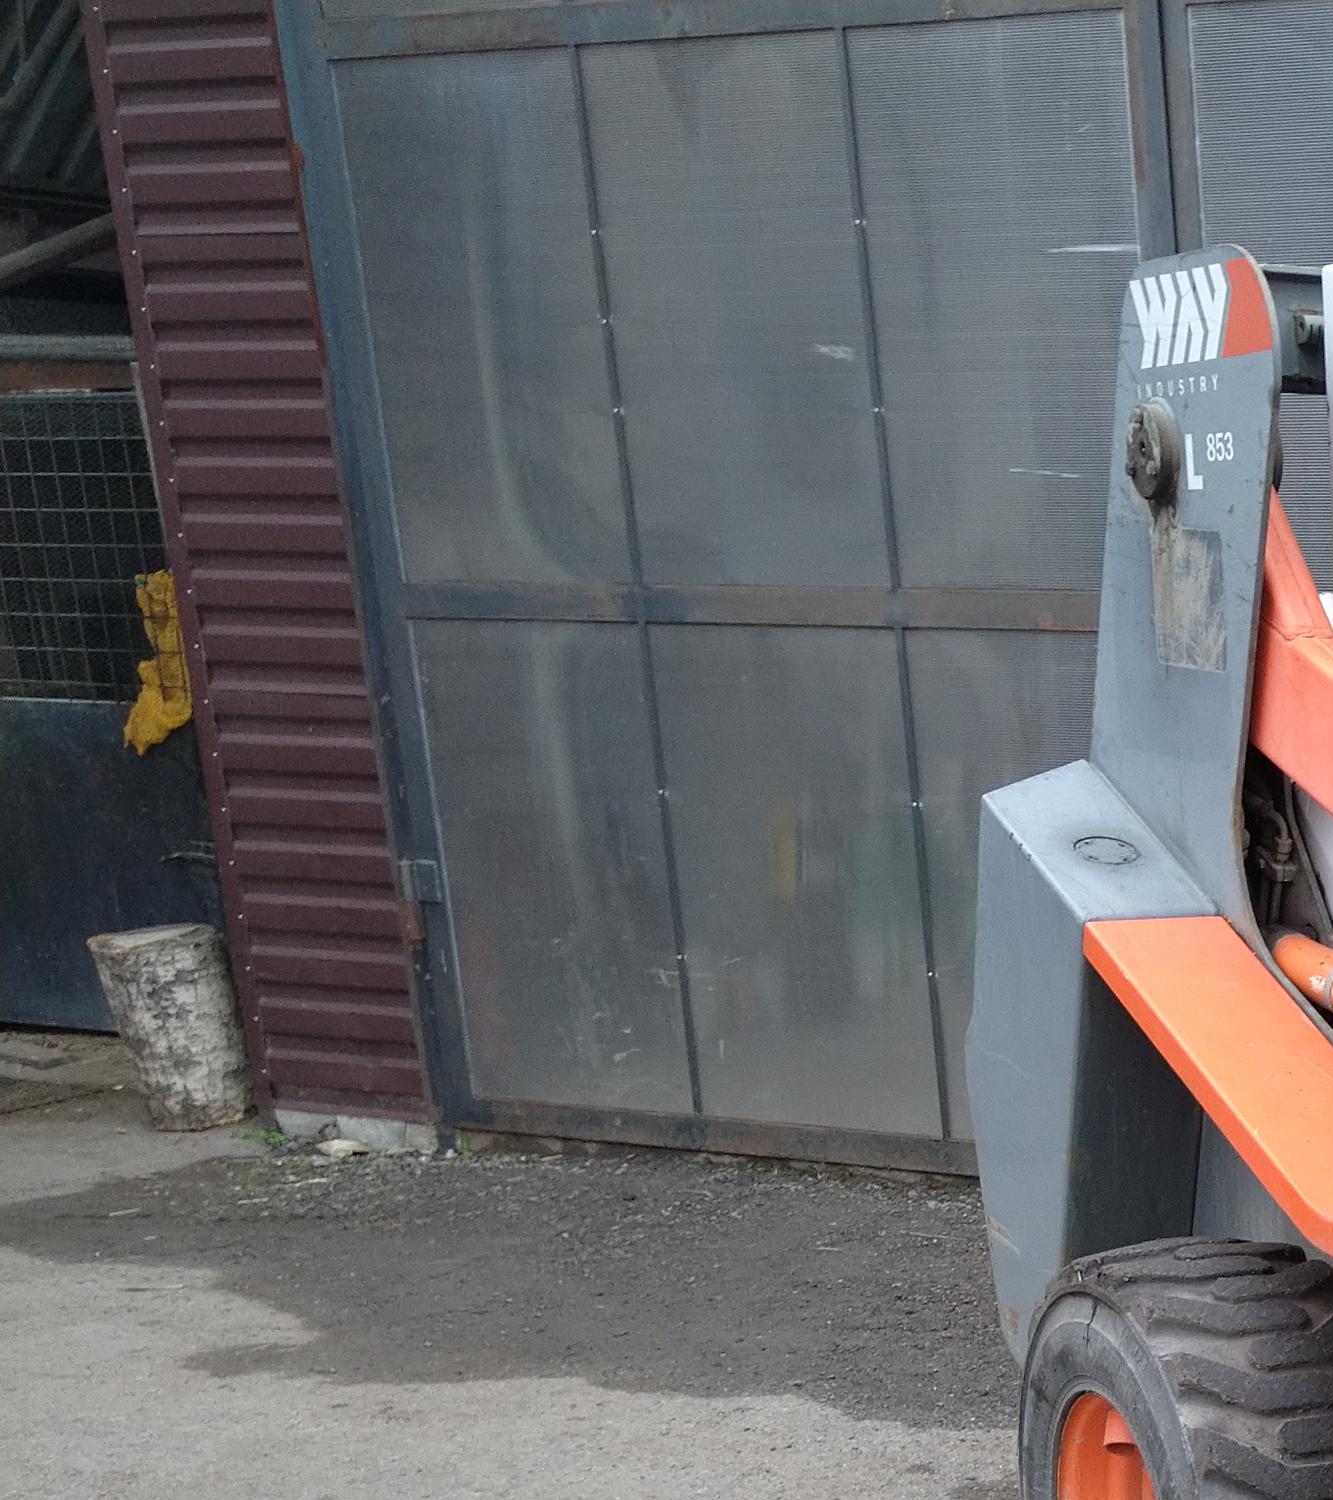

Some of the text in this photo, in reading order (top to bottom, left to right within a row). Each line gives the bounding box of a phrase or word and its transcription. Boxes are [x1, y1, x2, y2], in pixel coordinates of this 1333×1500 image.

[1129, 263, 1228, 370] WAY
[1137, 374, 1219, 400] INDUSTRY
[1185, 432, 1235, 490] L 853
